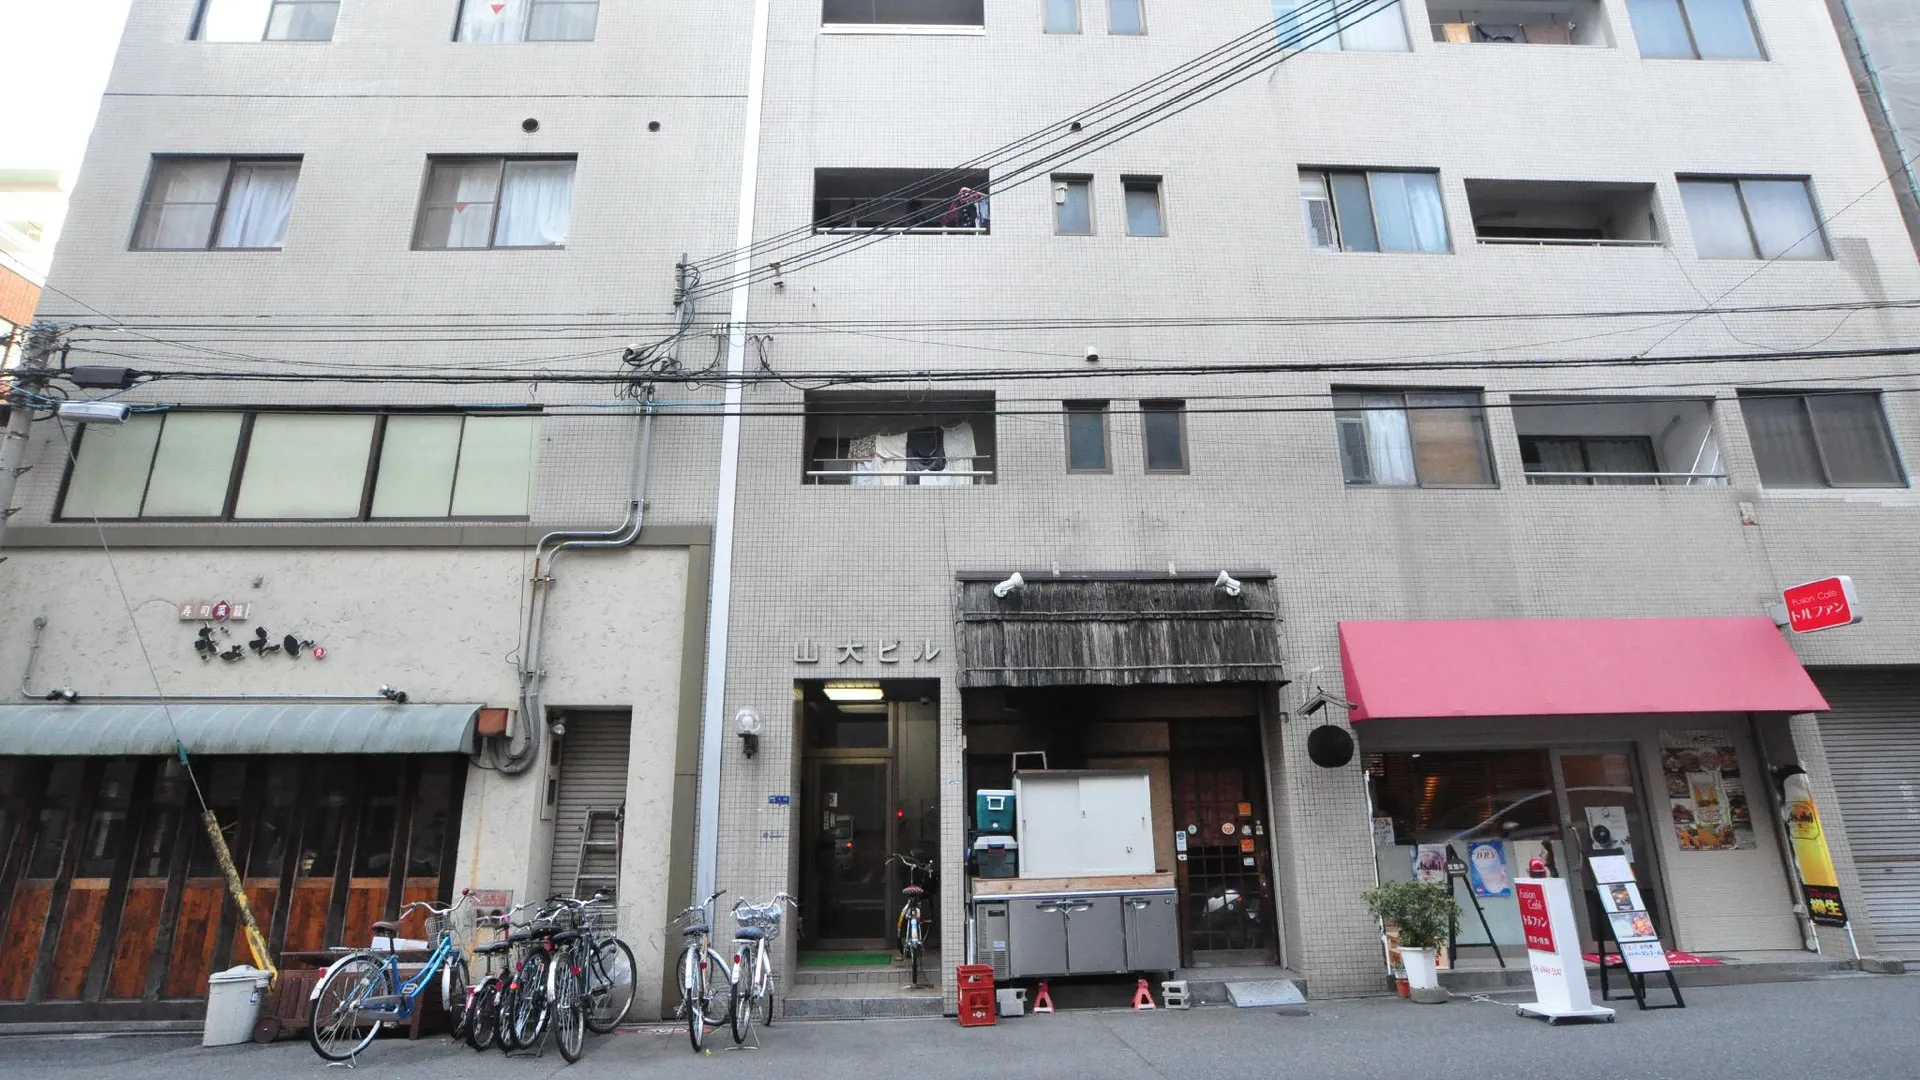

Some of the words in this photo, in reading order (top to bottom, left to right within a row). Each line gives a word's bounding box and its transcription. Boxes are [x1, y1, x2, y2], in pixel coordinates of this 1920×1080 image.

[1792, 595, 1814, 606] Fusion
[1791, 602, 1844, 622] トルファン
[793, 636, 941, 664] 山大ビル
[1476, 851, 1496, 860] DRY
[1522, 914, 1547, 927] トルファン
